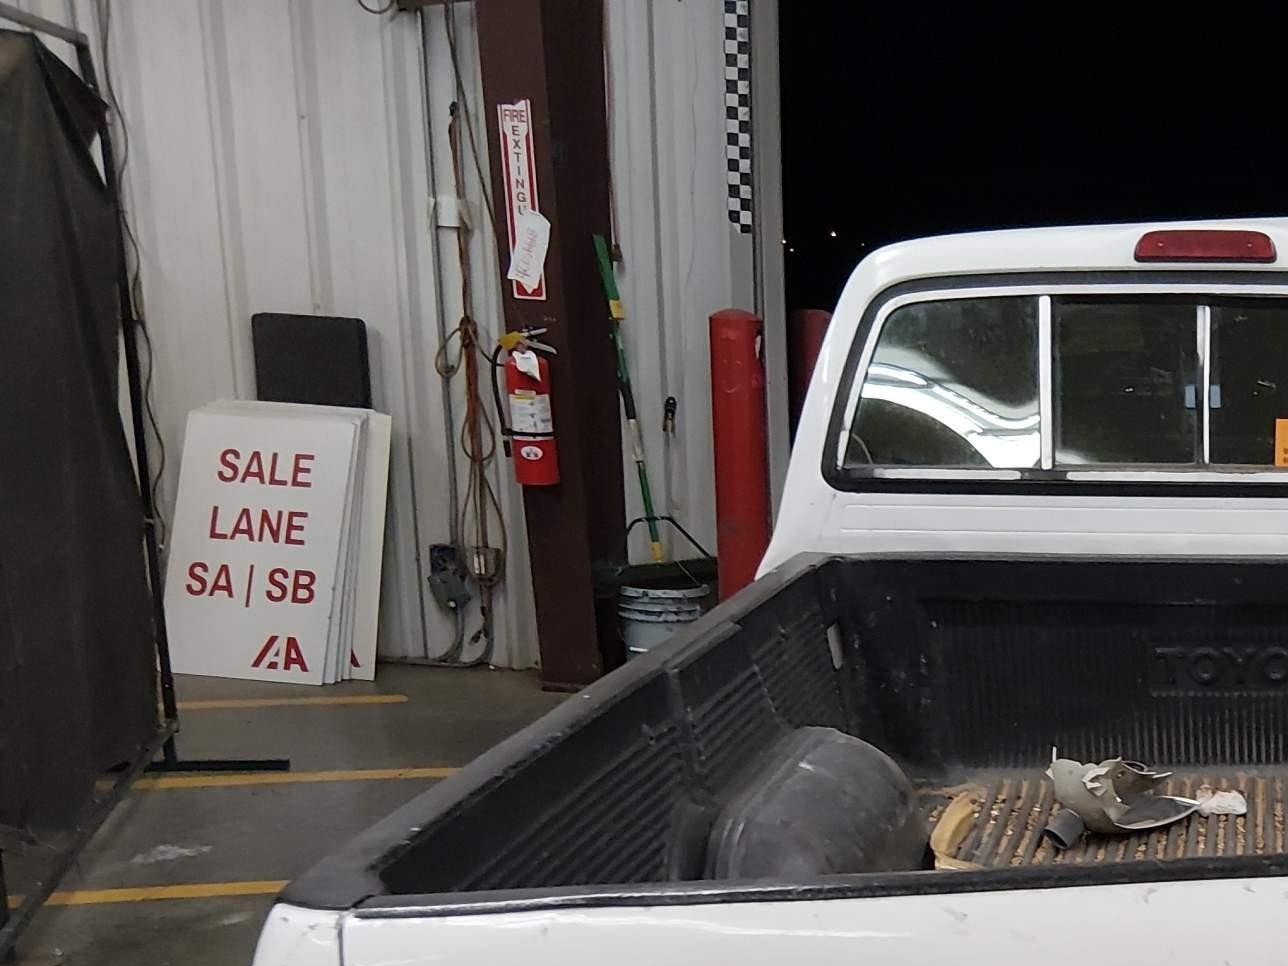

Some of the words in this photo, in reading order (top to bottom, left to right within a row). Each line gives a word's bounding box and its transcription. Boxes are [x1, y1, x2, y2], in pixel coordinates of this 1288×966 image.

[503, 109, 527, 123] FIRE
[217, 449, 315, 488] SALE
[209, 506, 308, 545] LANE
[186, 562, 234, 598] SA
[266, 568, 316, 604] SB
